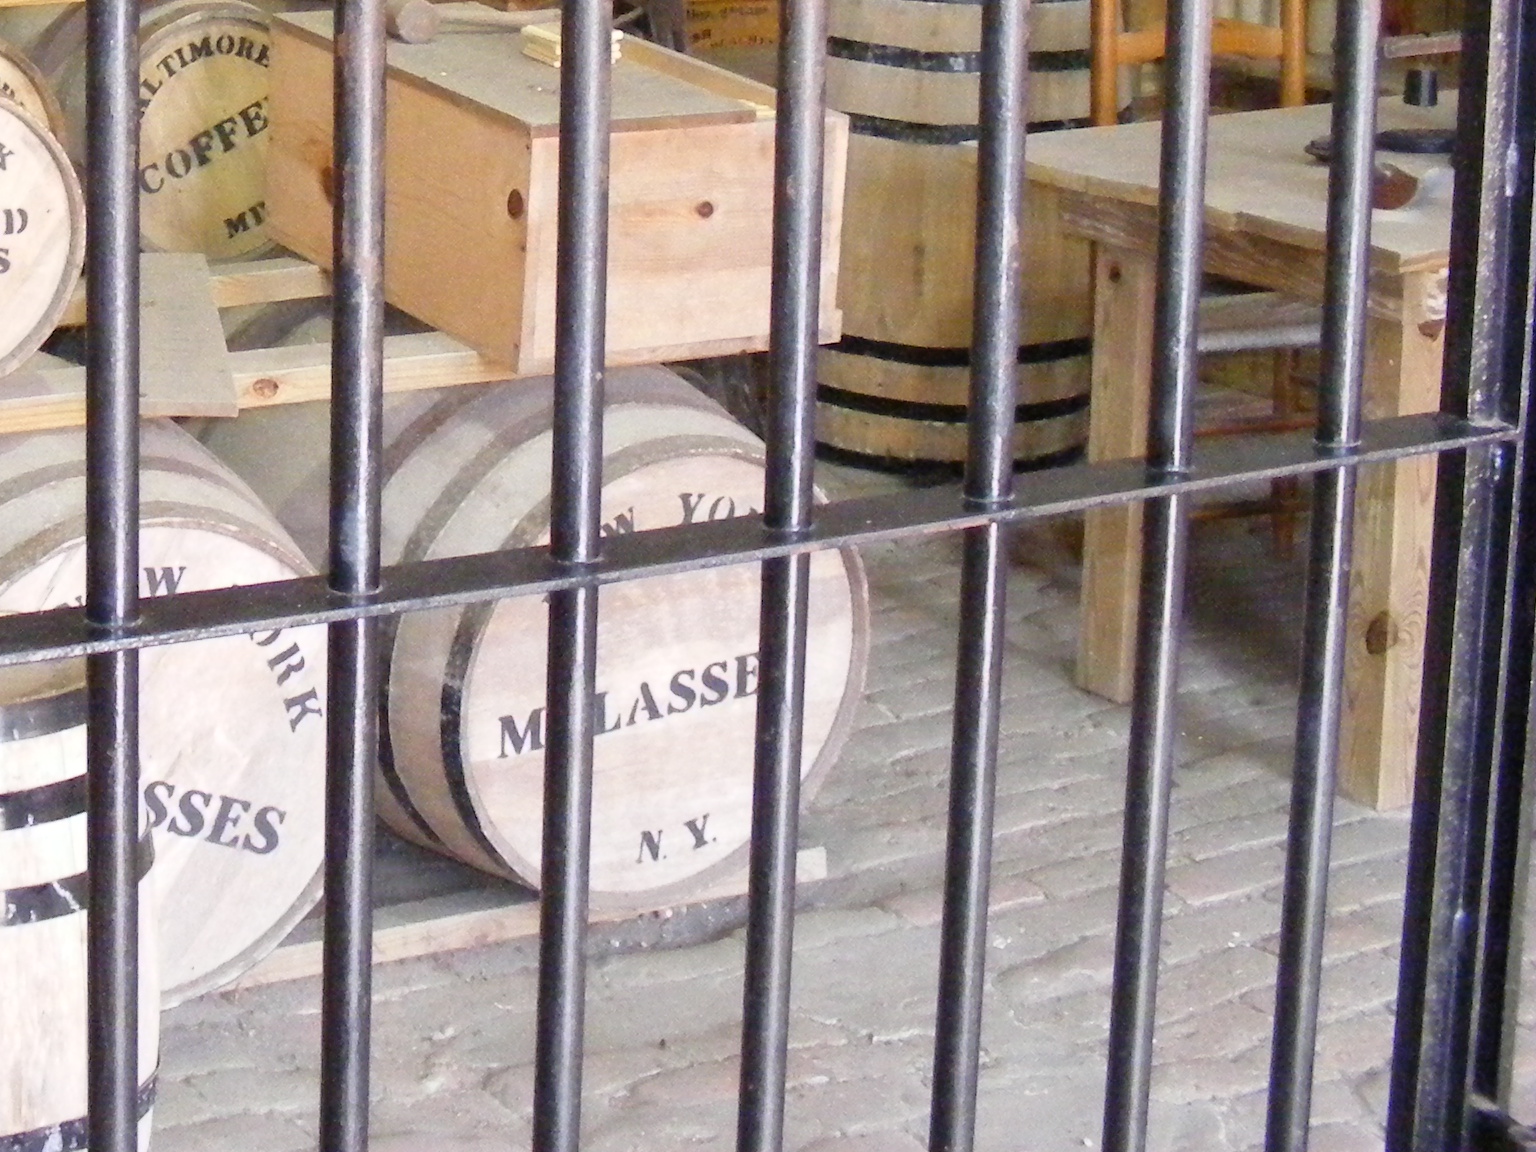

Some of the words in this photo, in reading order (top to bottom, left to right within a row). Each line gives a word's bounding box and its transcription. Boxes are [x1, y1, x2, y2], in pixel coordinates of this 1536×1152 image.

[138, 34, 270, 120] ALTIMORE
[139, 96, 269, 195] COFFE
[249, 626, 322, 733] RK
[497, 652, 760, 759] MLASSE
[142, 780, 287, 855] SSES
